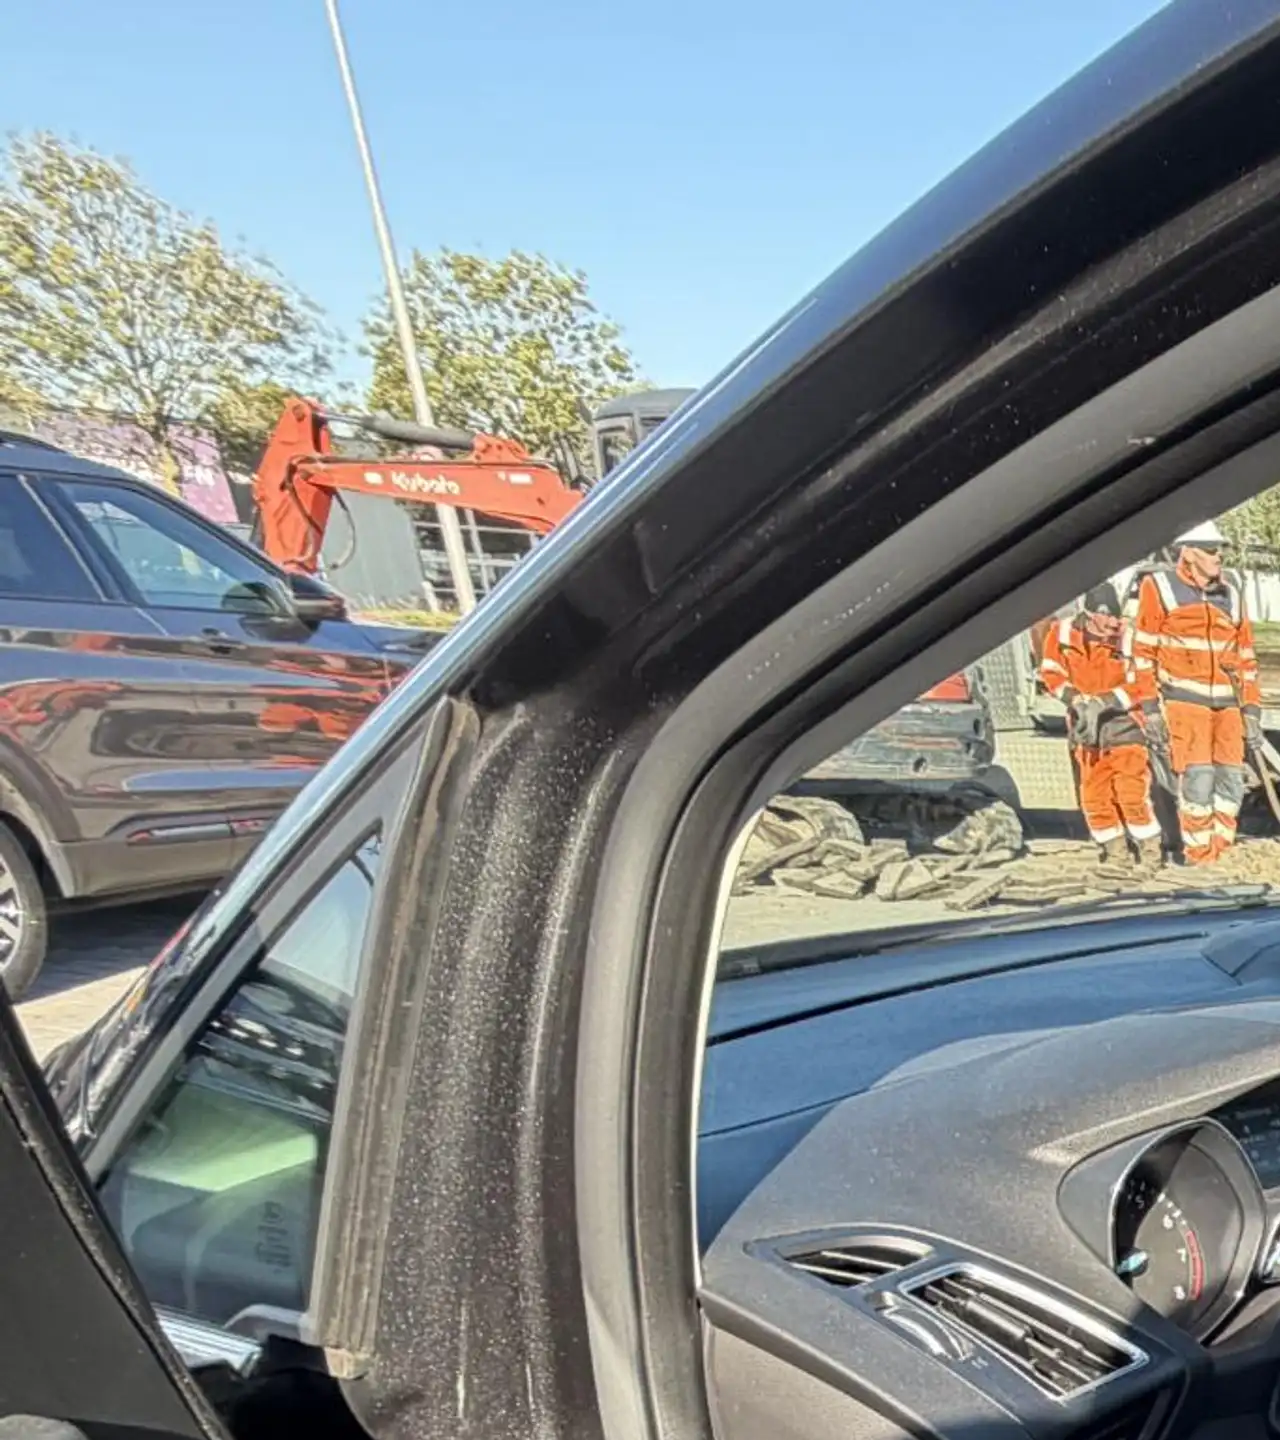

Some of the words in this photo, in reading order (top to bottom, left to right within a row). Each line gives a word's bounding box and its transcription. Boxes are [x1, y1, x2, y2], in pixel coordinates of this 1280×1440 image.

[390, 470, 461, 496] Kubota
[1162, 1213, 1174, 1230] 6
[1176, 1247, 1187, 1264] 7
